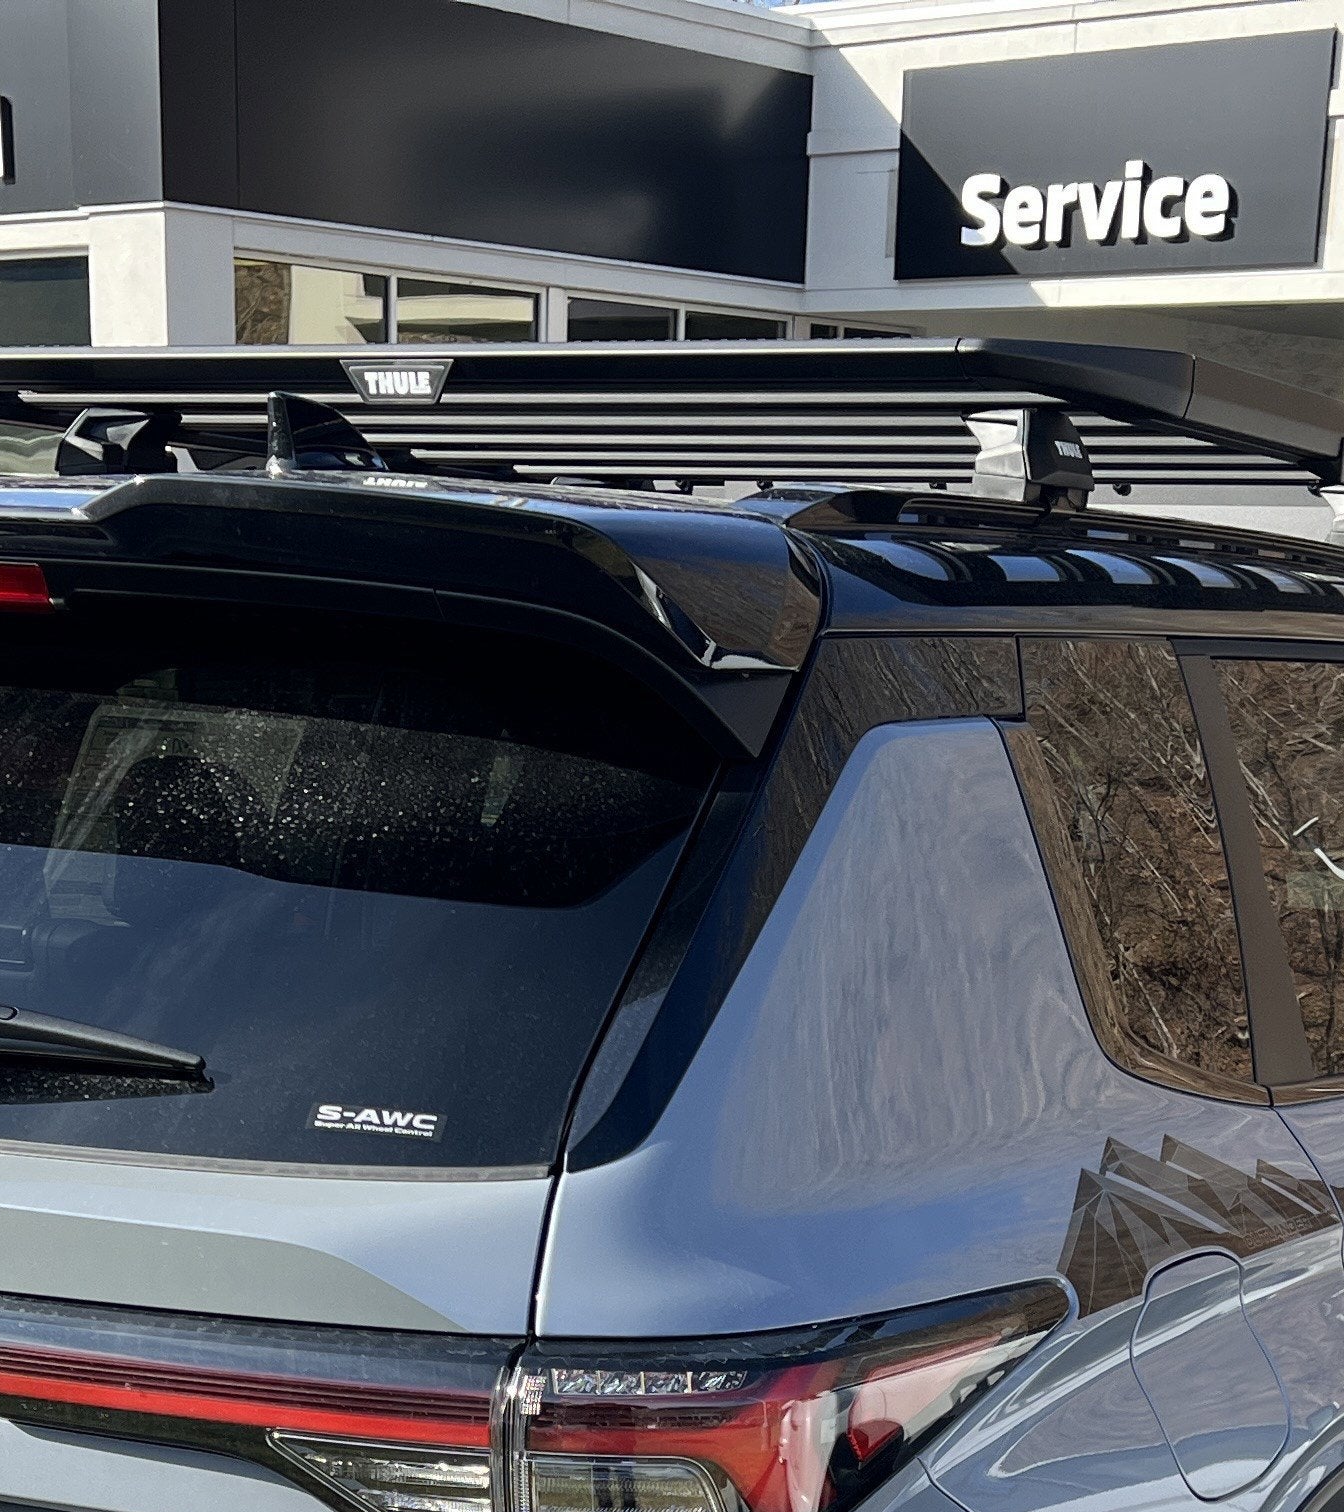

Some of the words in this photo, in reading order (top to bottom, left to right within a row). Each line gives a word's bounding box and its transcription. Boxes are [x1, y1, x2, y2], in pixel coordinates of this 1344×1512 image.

[960, 160, 1230, 246] Service
[364, 371, 432, 395] THULE
[316, 1104, 438, 1130] S-AWC
